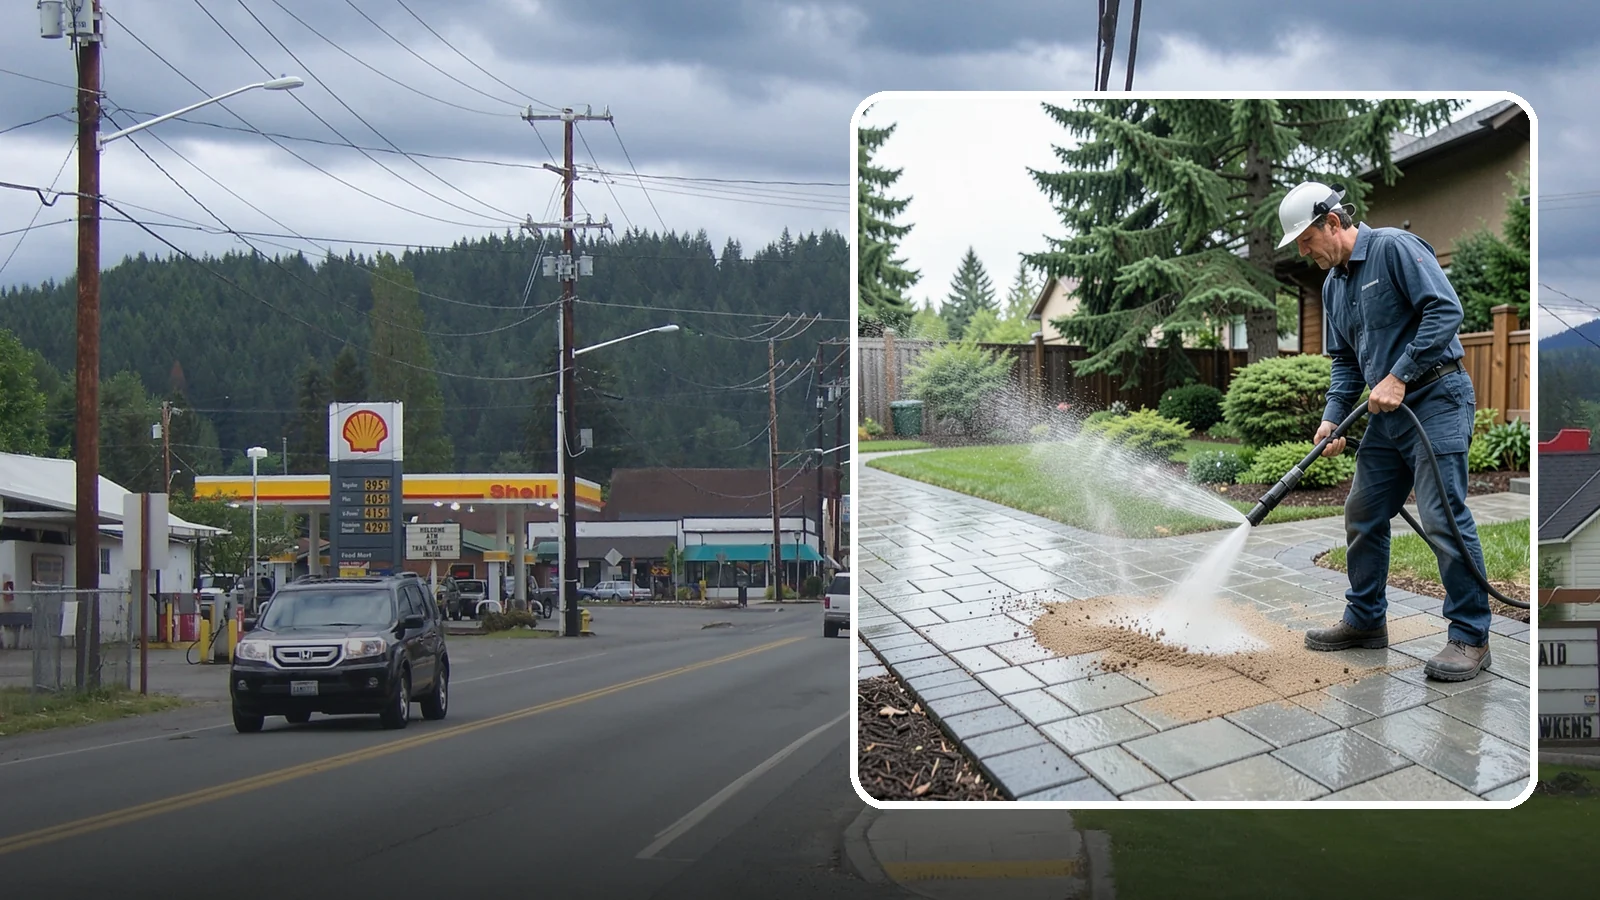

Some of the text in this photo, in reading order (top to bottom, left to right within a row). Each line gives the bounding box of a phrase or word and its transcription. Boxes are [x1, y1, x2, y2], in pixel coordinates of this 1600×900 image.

[366, 480, 384, 490] 395
[490, 484, 547, 499] Shell
[366, 494, 384, 504] 405
[366, 508, 383, 518] 415
[366, 522, 384, 532] 429
[1538, 642, 1567, 665] AID
[1538, 716, 1592, 739] WKENS
